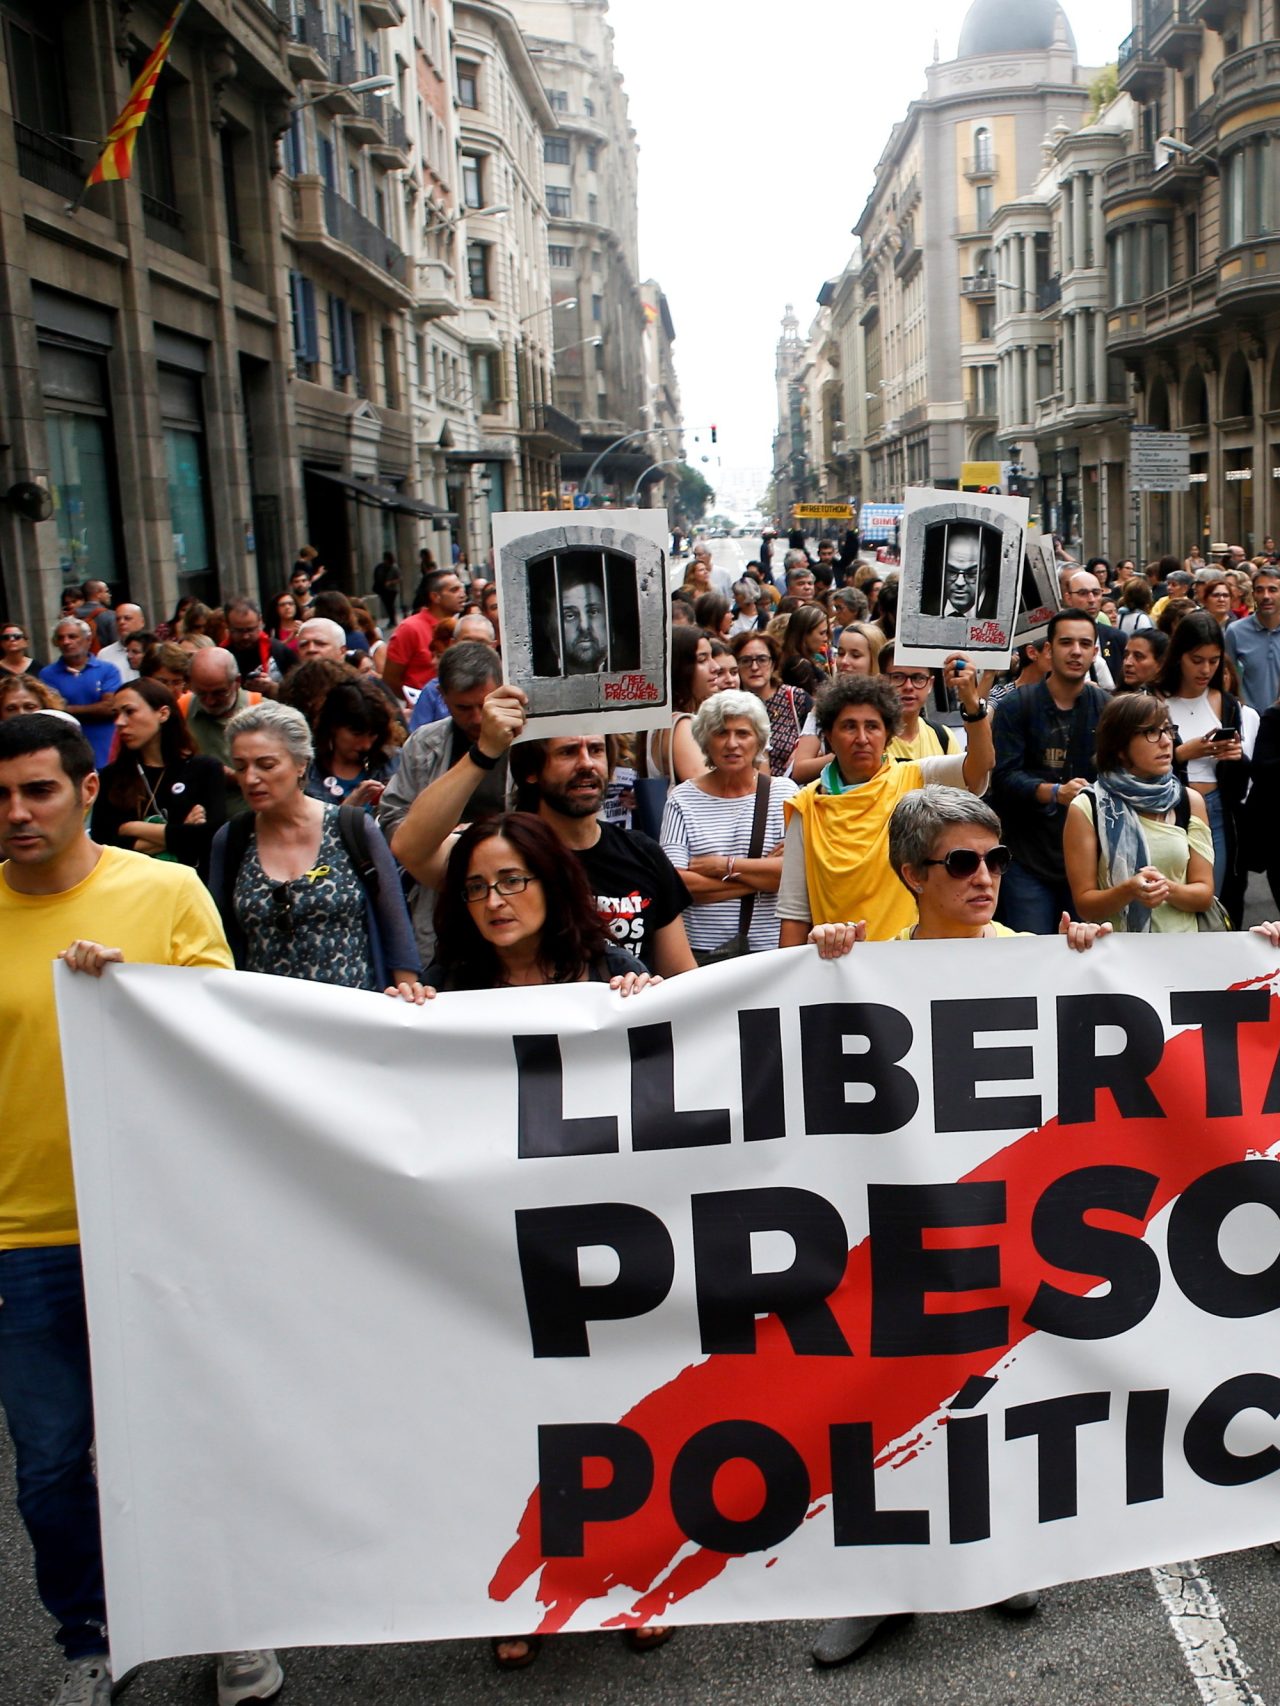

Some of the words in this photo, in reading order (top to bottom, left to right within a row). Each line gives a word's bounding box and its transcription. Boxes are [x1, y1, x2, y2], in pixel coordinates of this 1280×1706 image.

[605, 682, 658, 692] POLITICAL
[622, 674, 647, 690] FREE
[605, 691, 659, 701] PRISONERS
